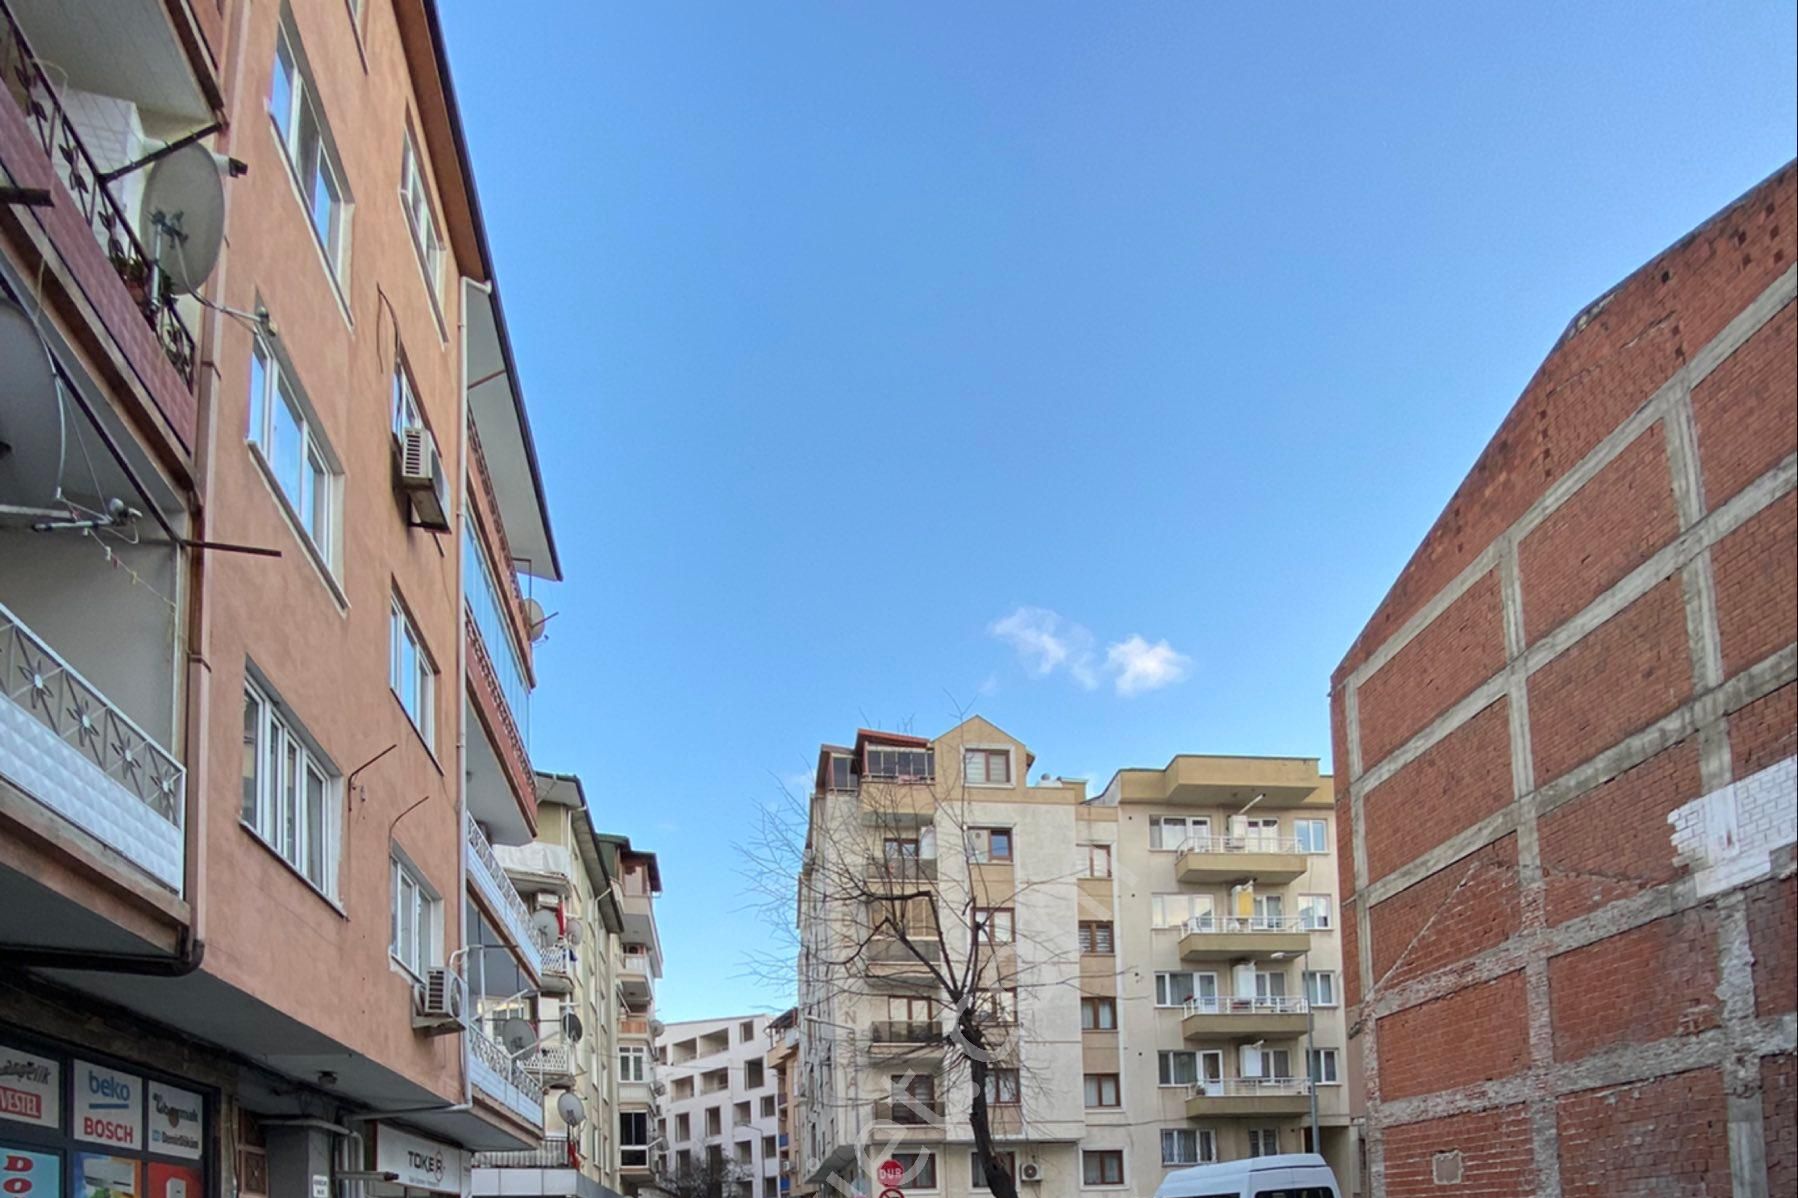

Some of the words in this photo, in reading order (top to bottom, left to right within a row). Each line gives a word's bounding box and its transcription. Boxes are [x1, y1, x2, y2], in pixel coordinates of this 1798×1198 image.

[88, 1070, 130, 1101] beko
[84, 1117, 133, 1144] BOSCH
[880, 1168, 902, 1180] DUR
